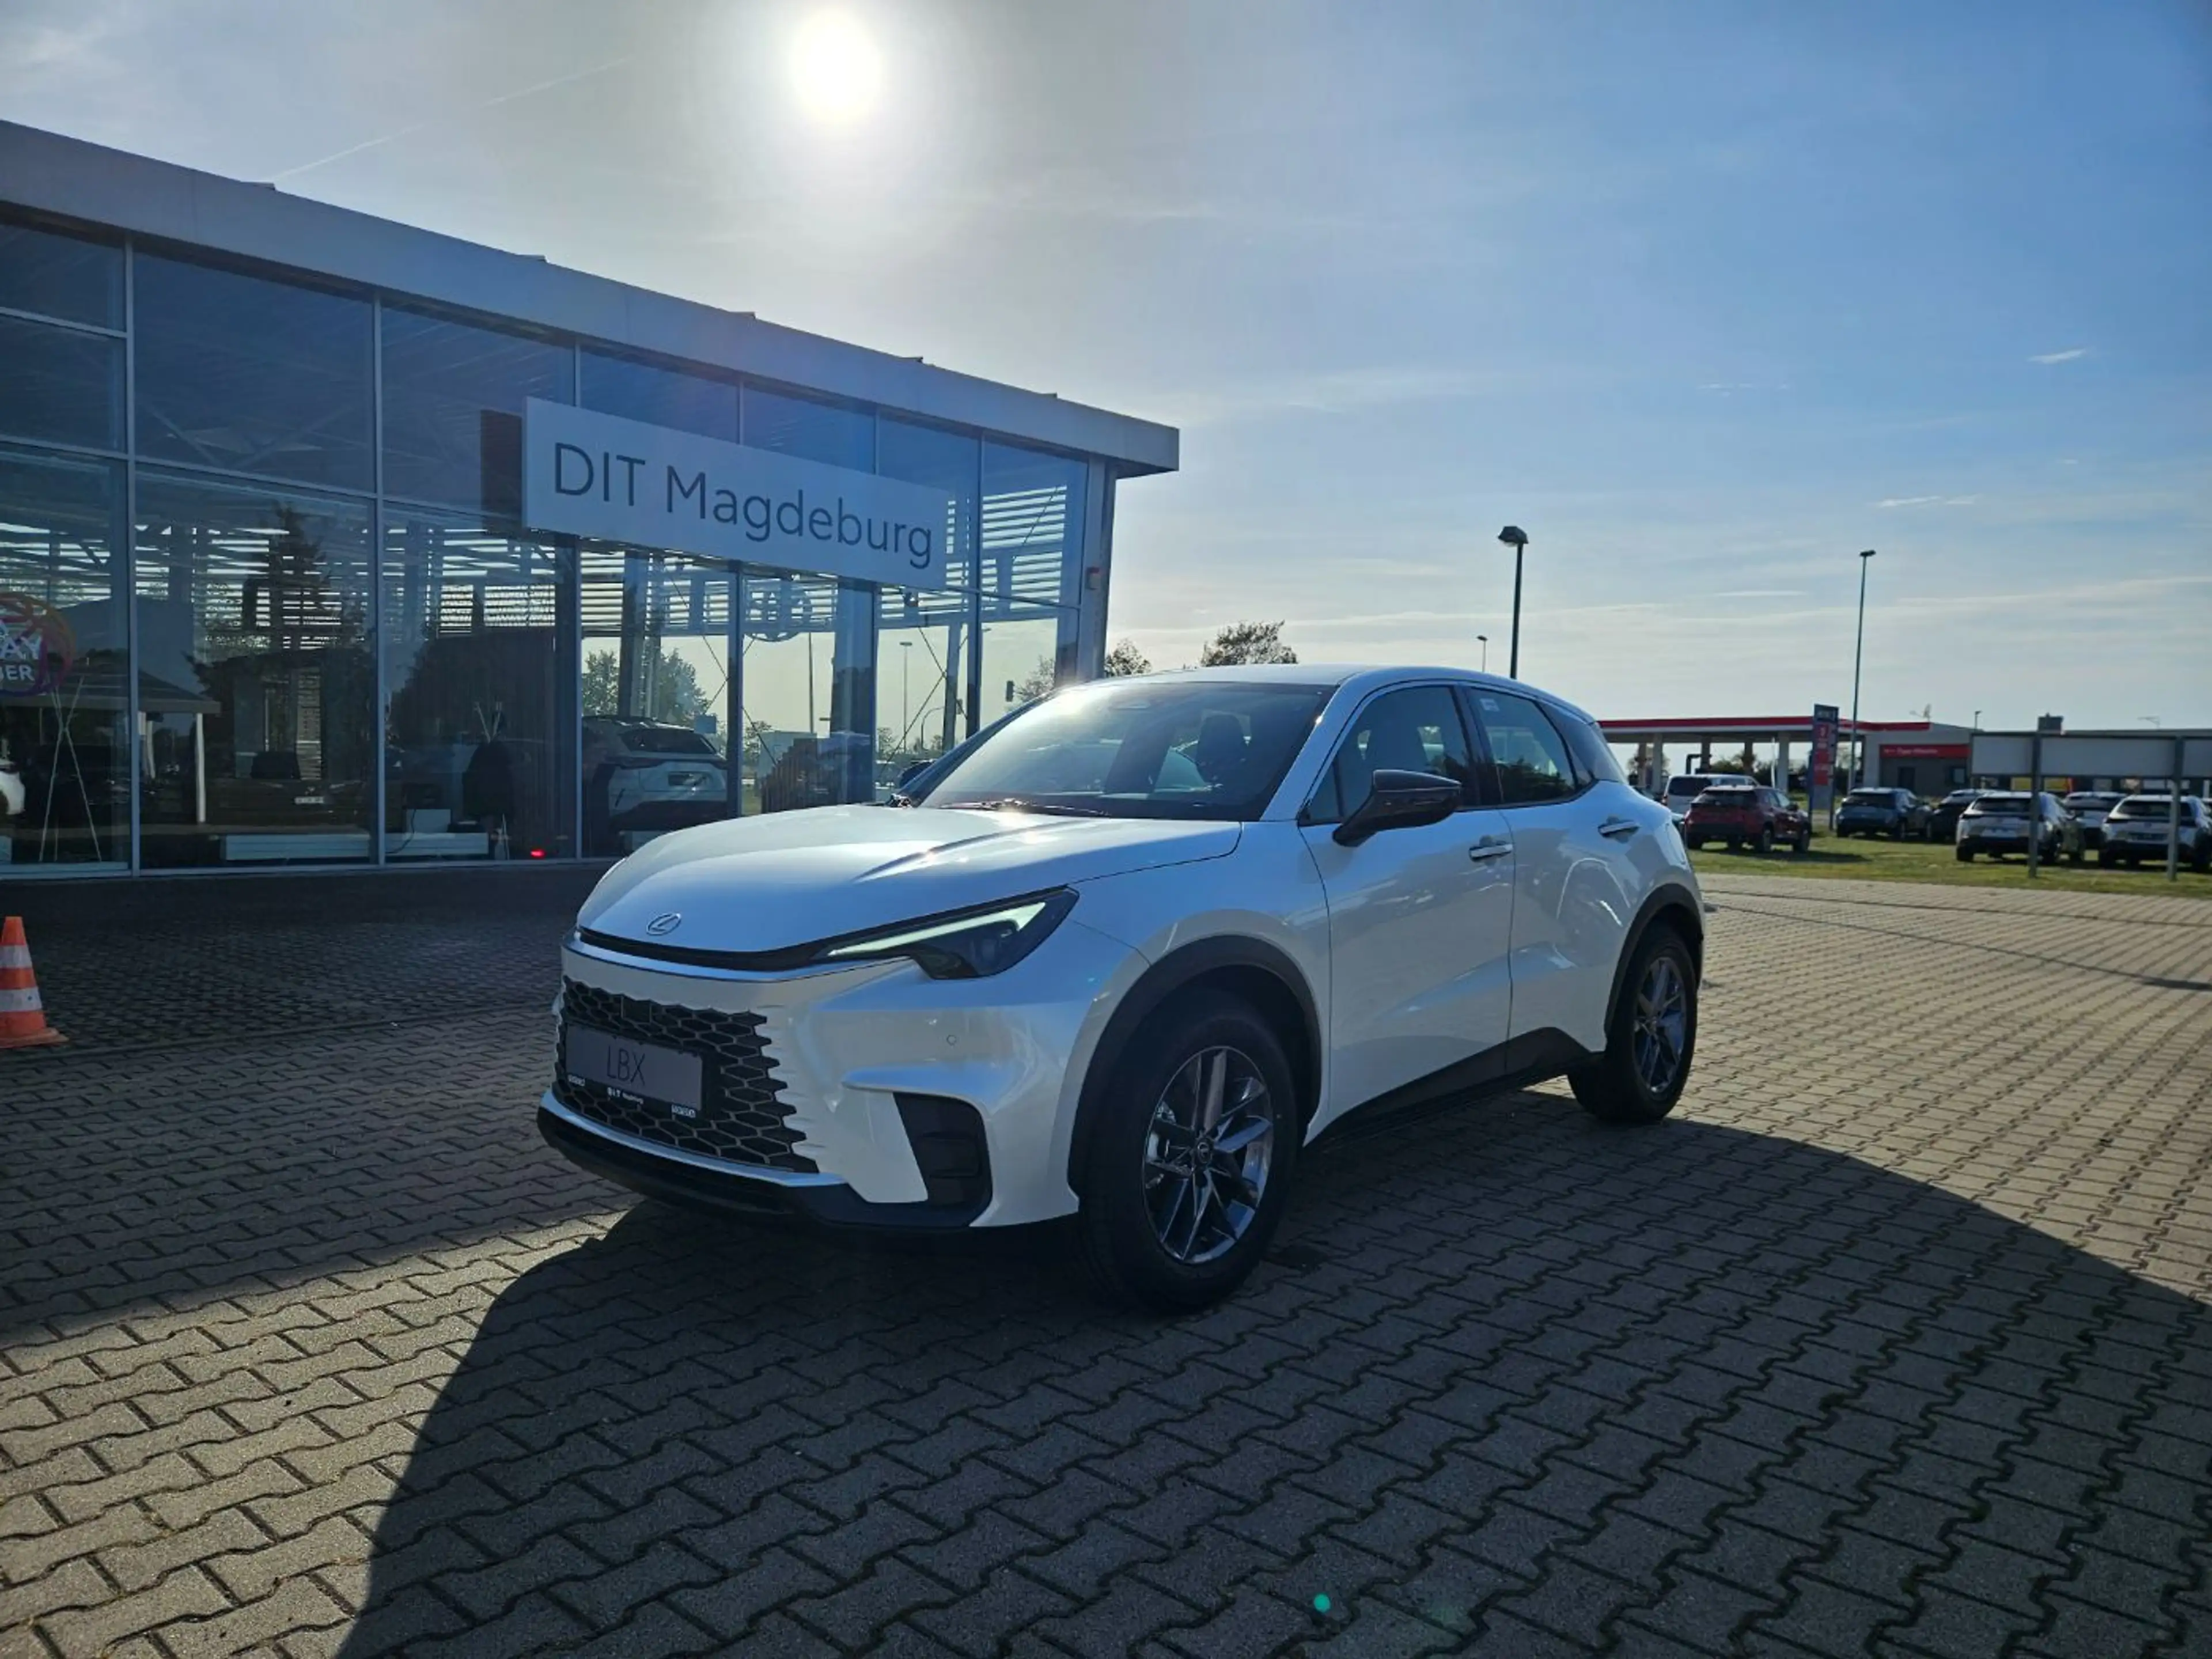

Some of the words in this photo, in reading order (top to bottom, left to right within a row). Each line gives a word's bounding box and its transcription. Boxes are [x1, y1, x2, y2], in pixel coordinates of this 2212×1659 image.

[555, 442, 646, 506] DIT
[666, 465, 931, 569] Magdeburg
[607, 1045, 645, 1086] LBX
